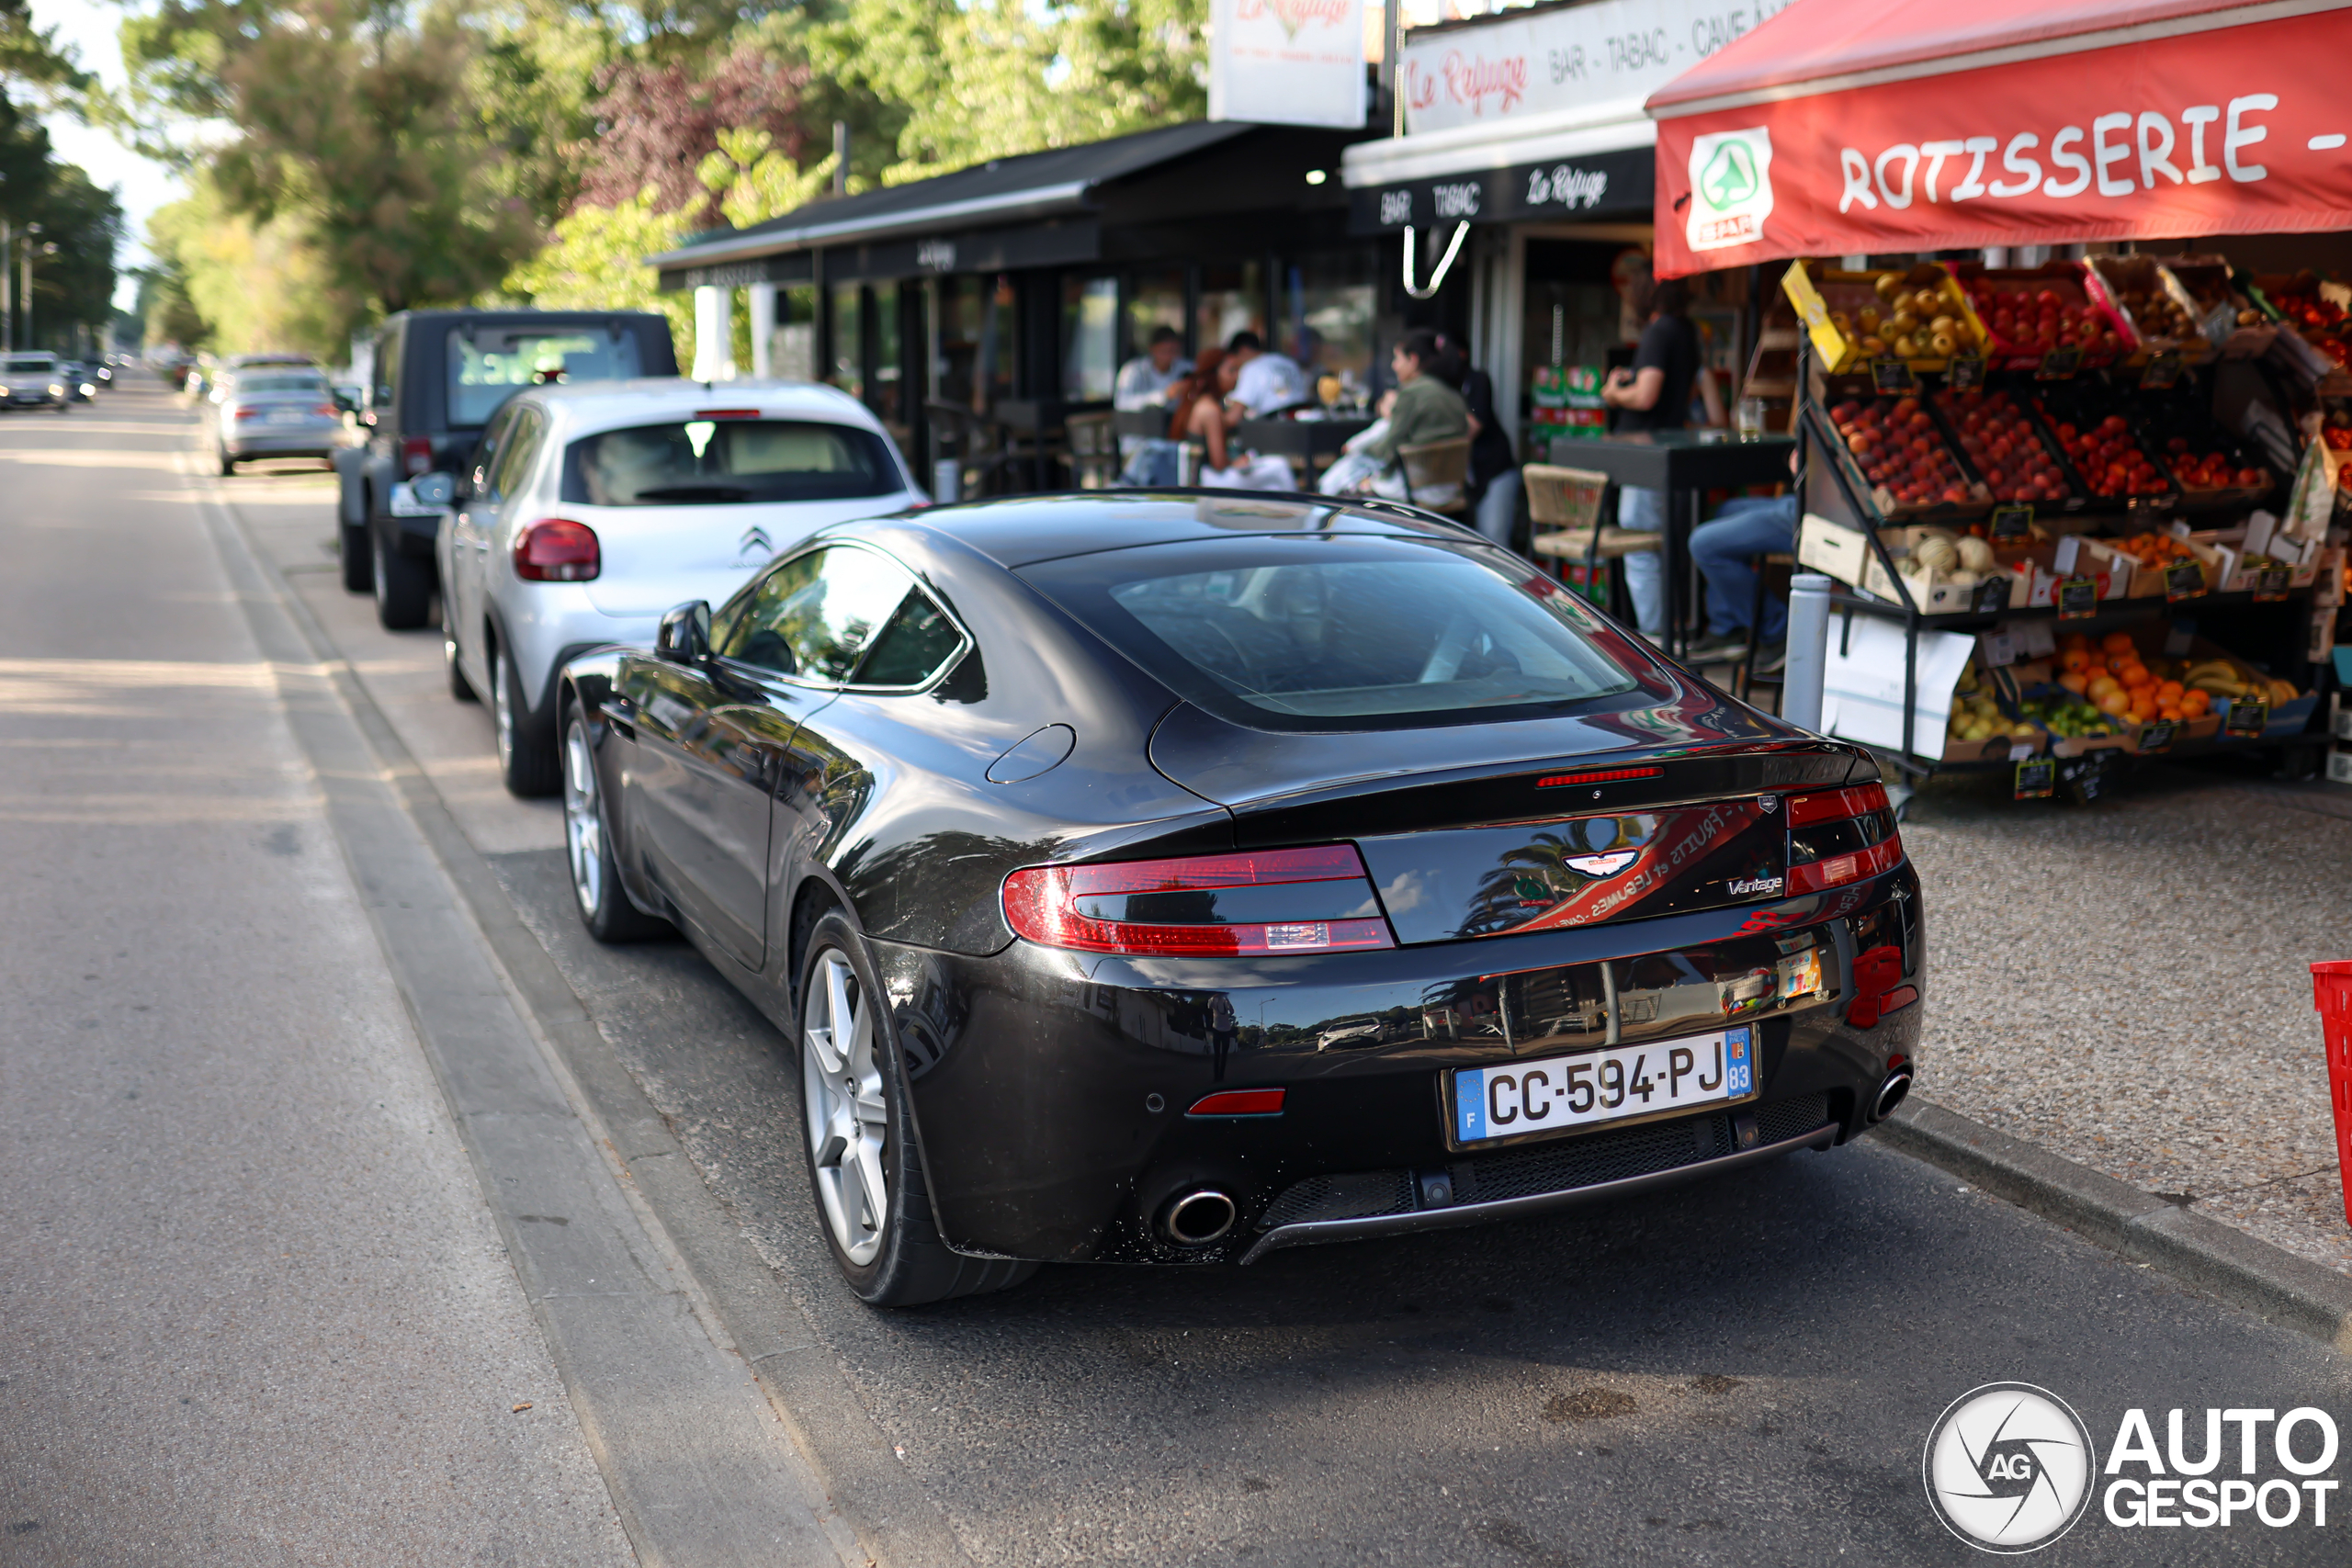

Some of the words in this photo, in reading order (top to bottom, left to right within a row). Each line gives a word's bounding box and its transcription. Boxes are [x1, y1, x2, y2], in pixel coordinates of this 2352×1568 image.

[1547, 47, 1587, 85] BAR
[1604, 28, 1670, 73] TABAC
[1405, 61, 1437, 110] Le
[1439, 49, 1530, 116] Refuge
[1838, 93, 2278, 214] ROTISSERIE
[1381, 189, 1412, 224] BAR
[1433, 182, 1481, 219] TABAC
[1527, 169, 1548, 205] Le
[1550, 164, 1608, 210] Refuge
[1700, 216, 1752, 242] SPAR
[1728, 877, 1783, 895] Vantage
[1488, 1041, 1723, 1125] CC-594-PJ
[1729, 1065, 1749, 1089] 83
[1466, 1112, 1476, 1128] F
